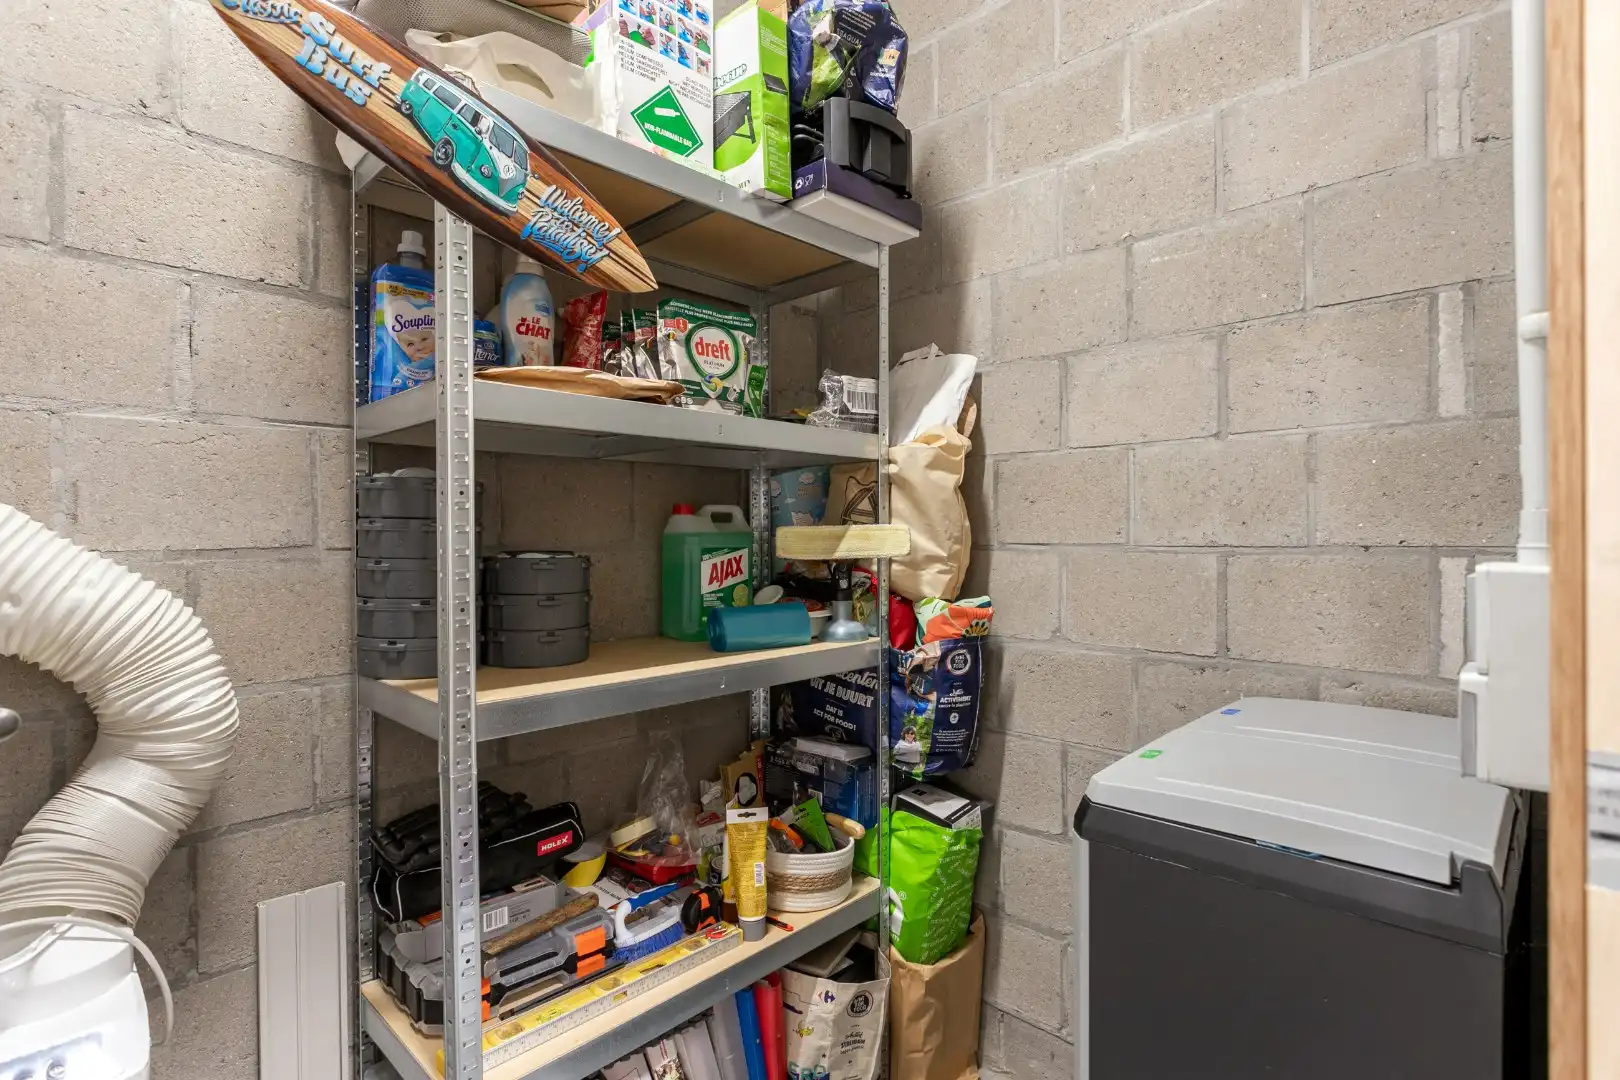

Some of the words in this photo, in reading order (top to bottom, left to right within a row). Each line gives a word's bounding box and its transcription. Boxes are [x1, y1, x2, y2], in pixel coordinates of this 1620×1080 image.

[301, 11, 392, 89] Surf
[293, 36, 372, 107] Bus
[644, 122, 683, 144] NON-FLAMMABLE
[683, 138, 692, 148] GAS
[515, 322, 551, 340] CHAT
[532, 317, 541, 325] LE
[694, 336, 731, 362] dreft
[707, 554, 744, 588] AJAX
[824, 681, 836, 695] JE
[836, 686, 875, 708] BUURT
[824, 712, 834, 722] FOR
[825, 704, 837, 714] DAT
[541, 835, 568, 851] HOLEX
